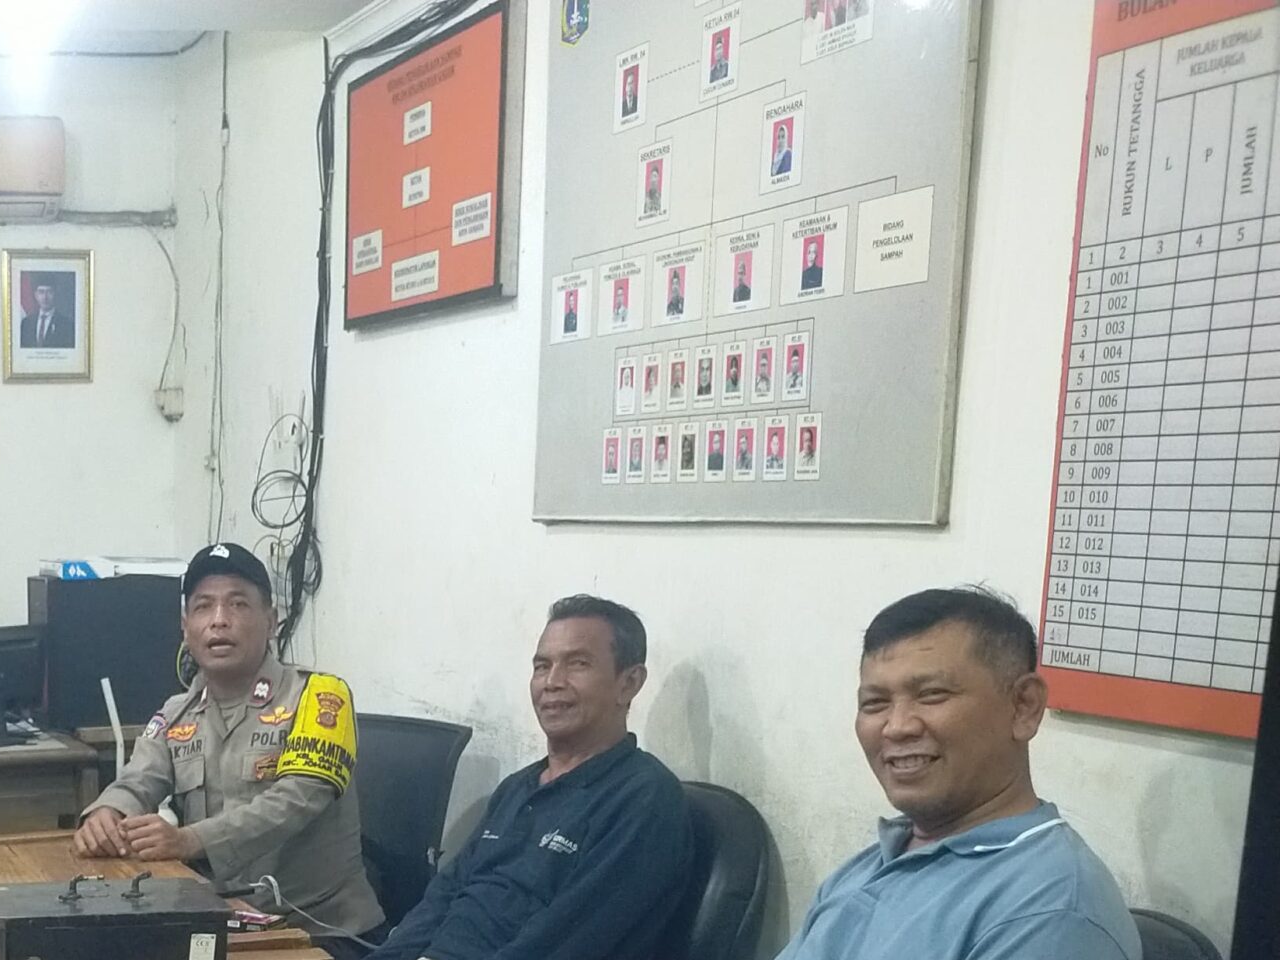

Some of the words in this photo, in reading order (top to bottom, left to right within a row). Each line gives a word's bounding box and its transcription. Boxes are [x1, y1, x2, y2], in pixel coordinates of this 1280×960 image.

[1177, 38, 1219, 64] JUMLAH
[1221, 27, 1263, 49] KEPALA
[1189, 51, 1246, 77] KELUARGA
[765, 99, 803, 120] BENDAHARA
[1127, 68, 1146, 158] TETANGGA
[640, 144, 671, 163] SEKRETARIS
[1095, 144, 1109, 158] No
[1205, 148, 1213, 162] P
[1165, 157, 1172, 171] L
[1240, 126, 1258, 196] JUMLAH
[1122, 161, 1136, 217] RUKUN
[799, 215, 826, 229] KEAMANAN
[882, 220, 904, 232] BIDANG
[792, 227, 822, 239] KETERTIBAN
[1236, 227, 1244, 242] 5
[872, 233, 914, 248] PENGELOLAAN
[1195, 233, 1203, 248] 4
[1119, 246, 1126, 260] 2
[1156, 241, 1163, 255] 3
[880, 250, 904, 262] SAMPAH
[1088, 252, 1094, 266] 1
[1085, 276, 1092, 289] 1
[1110, 272, 1129, 286] 001
[1082, 301, 1091, 313] 2
[1108, 296, 1128, 310] 002
[1080, 325, 1088, 337] 3
[1106, 321, 1126, 335] 003
[1078, 349, 1086, 361] 4
[1103, 346, 1123, 359] 004
[1076, 373, 1084, 385] 5
[1101, 370, 1121, 383] 005
[1074, 397, 1081, 409] 6
[1099, 395, 1118, 408] 006
[1072, 420, 1079, 432] 7
[1096, 419, 1116, 432] 007
[1069, 444, 1077, 456] 8
[1094, 443, 1114, 456] 008
[1067, 467, 1075, 479] 9
[1092, 467, 1111, 479] 009
[1063, 491, 1076, 503] 10
[1089, 491, 1109, 503] 010
[1061, 514, 1072, 526] 11
[1087, 514, 1105, 527] 011
[1059, 537, 1071, 549] 12
[1085, 537, 1104, 550] 012
[1057, 560, 1069, 572] 13
[1083, 561, 1102, 574] 013
[1054, 583, 1067, 594] 14
[1081, 584, 1099, 597] 014
[1052, 605, 1065, 617] 15
[1078, 607, 1097, 620] 015
[1050, 649, 1090, 667] JUMLAH
